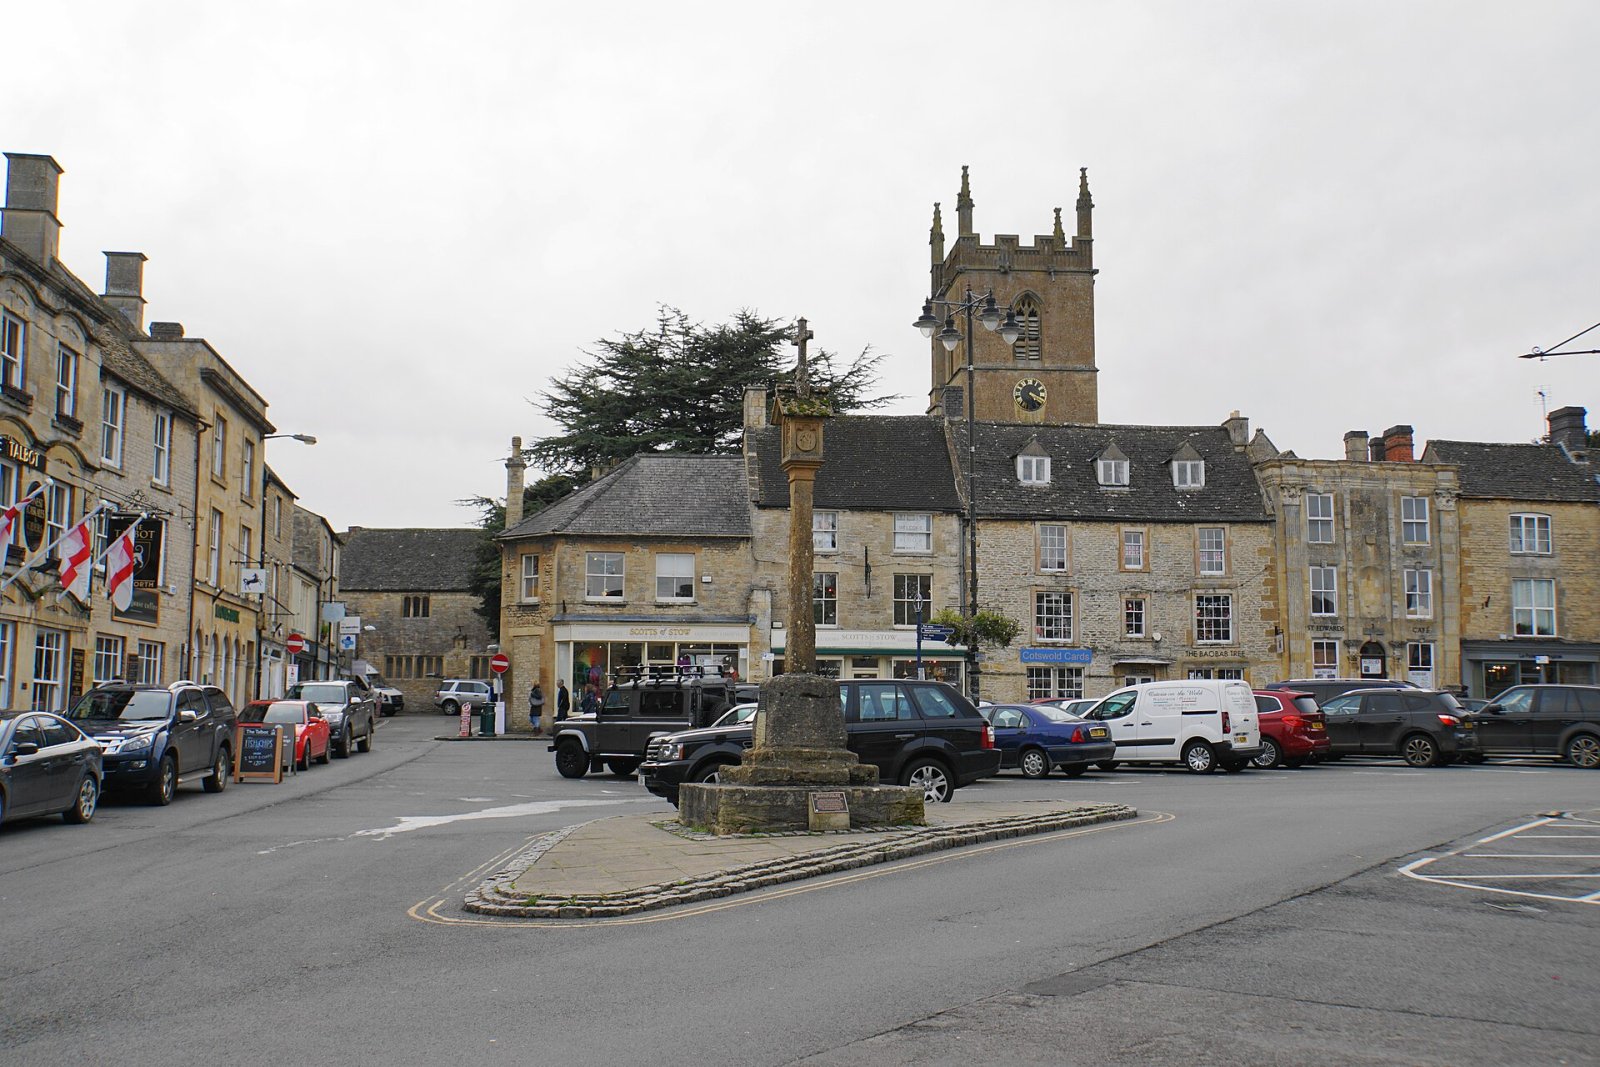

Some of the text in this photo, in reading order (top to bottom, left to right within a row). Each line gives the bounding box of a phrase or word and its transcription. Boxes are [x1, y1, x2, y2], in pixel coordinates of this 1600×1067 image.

[9, 441, 40, 467] TALBOT
[629, 628, 658, 636] SCOTTS
[669, 628, 691, 636] STOW
[1022, 651, 1090, 661] Cotswold Cards
[1199, 650, 1229, 658] BAOBAB
[1230, 650, 1246, 658] TREE
